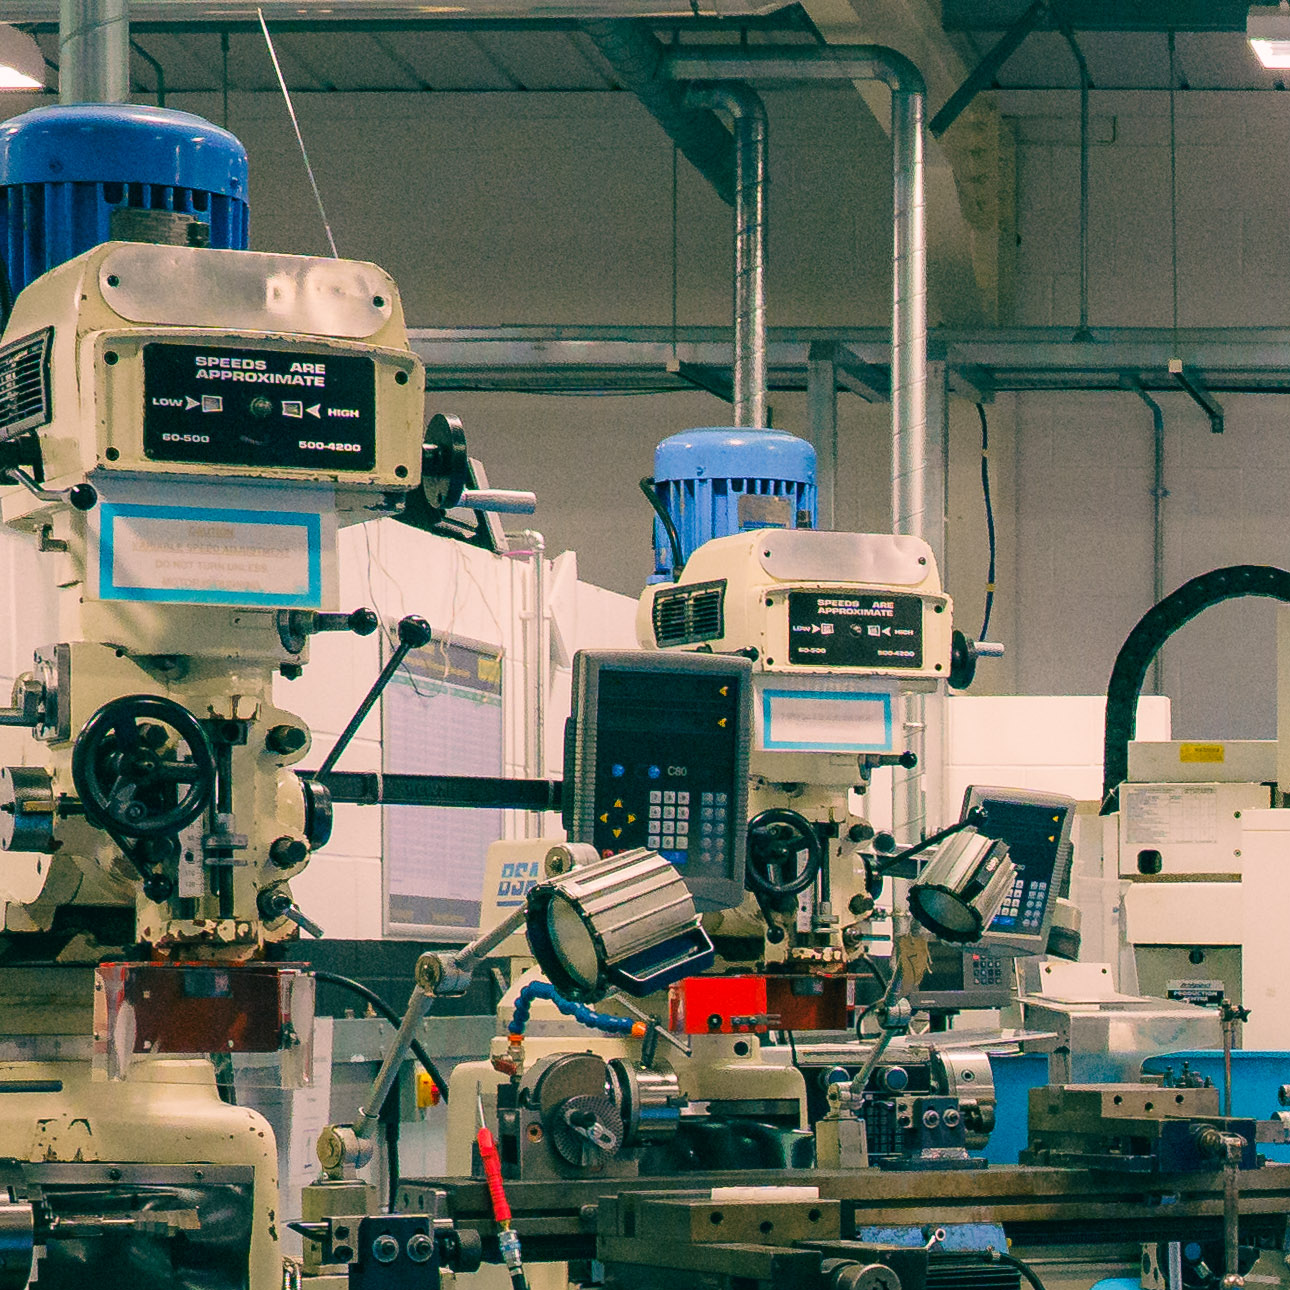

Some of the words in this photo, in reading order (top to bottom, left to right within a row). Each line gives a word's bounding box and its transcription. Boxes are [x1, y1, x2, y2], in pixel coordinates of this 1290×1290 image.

[195, 356, 267, 370] SPEEDS
[290, 362, 326, 374] ARE
[195, 369, 326, 387] APPROXIMATE
[152, 397, 183, 407] LOW
[327, 408, 360, 418] HIGH
[162, 432, 210, 443] 60-500
[298, 440, 361, 452] 500-4200
[817, 599, 860, 607] SPEEDS
[872, 601, 895, 609] ARE
[817, 607, 894, 617] APPROXIMATE
[667, 765, 688, 777] C80
